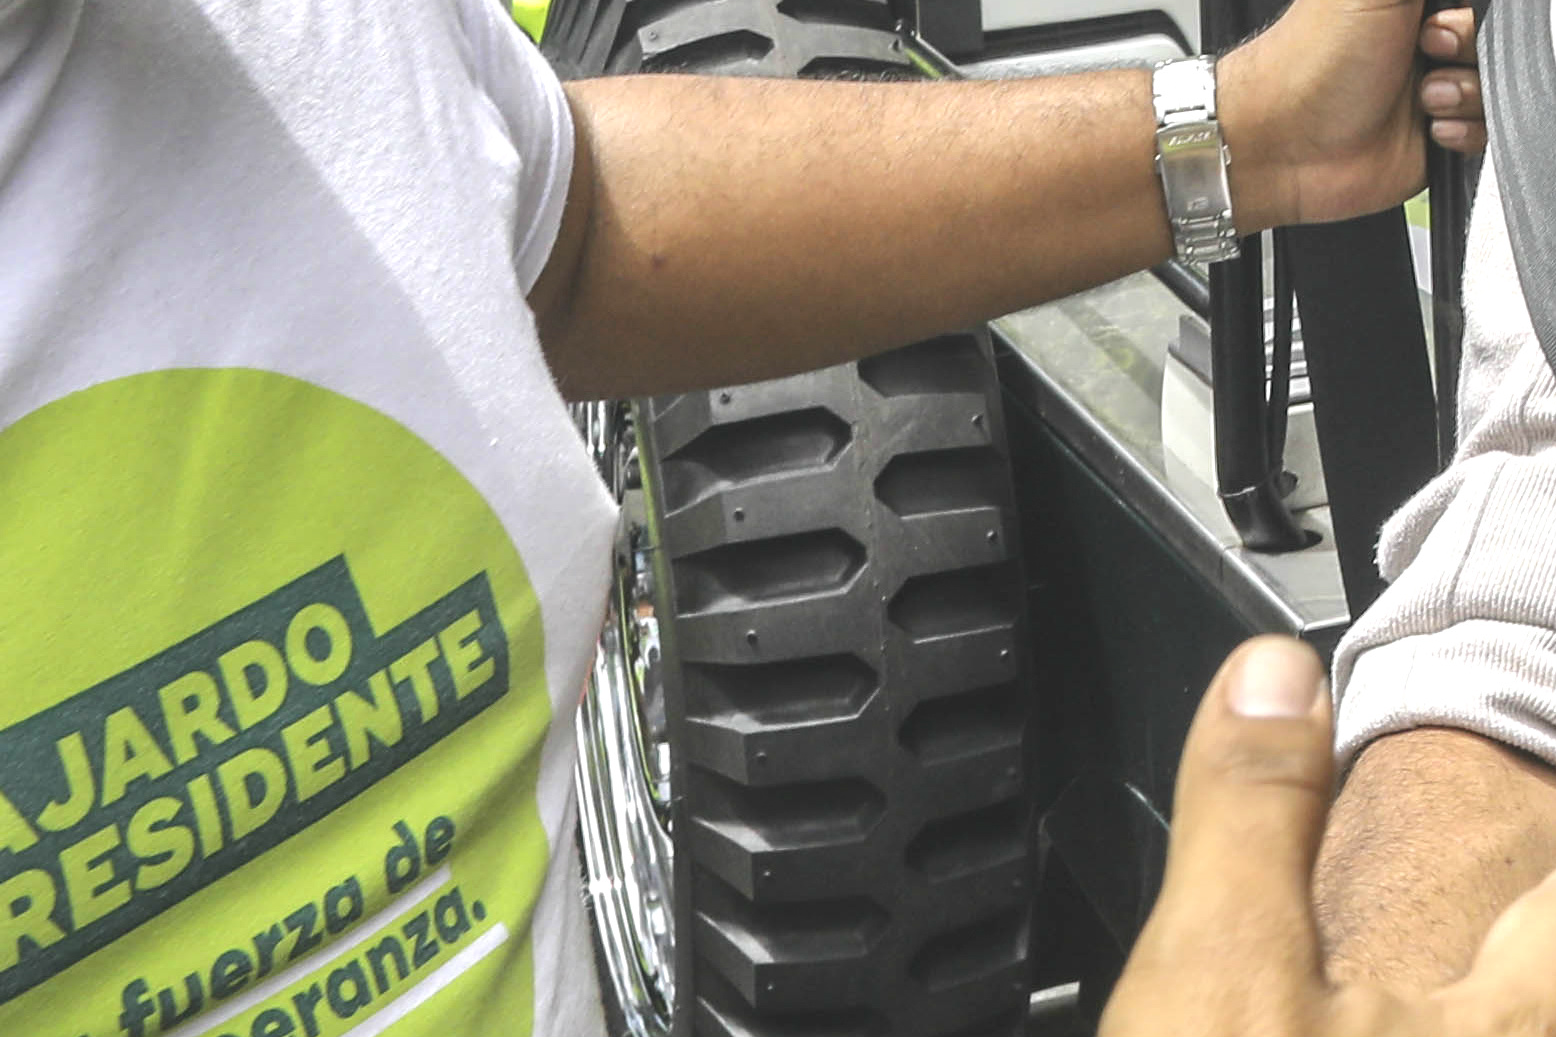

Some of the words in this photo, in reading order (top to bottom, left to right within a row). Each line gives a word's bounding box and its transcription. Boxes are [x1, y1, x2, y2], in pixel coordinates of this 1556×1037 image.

[118, 876, 365, 1037] fuerza
[383, 814, 456, 894] de
[217, 885, 487, 1037] eranza.
